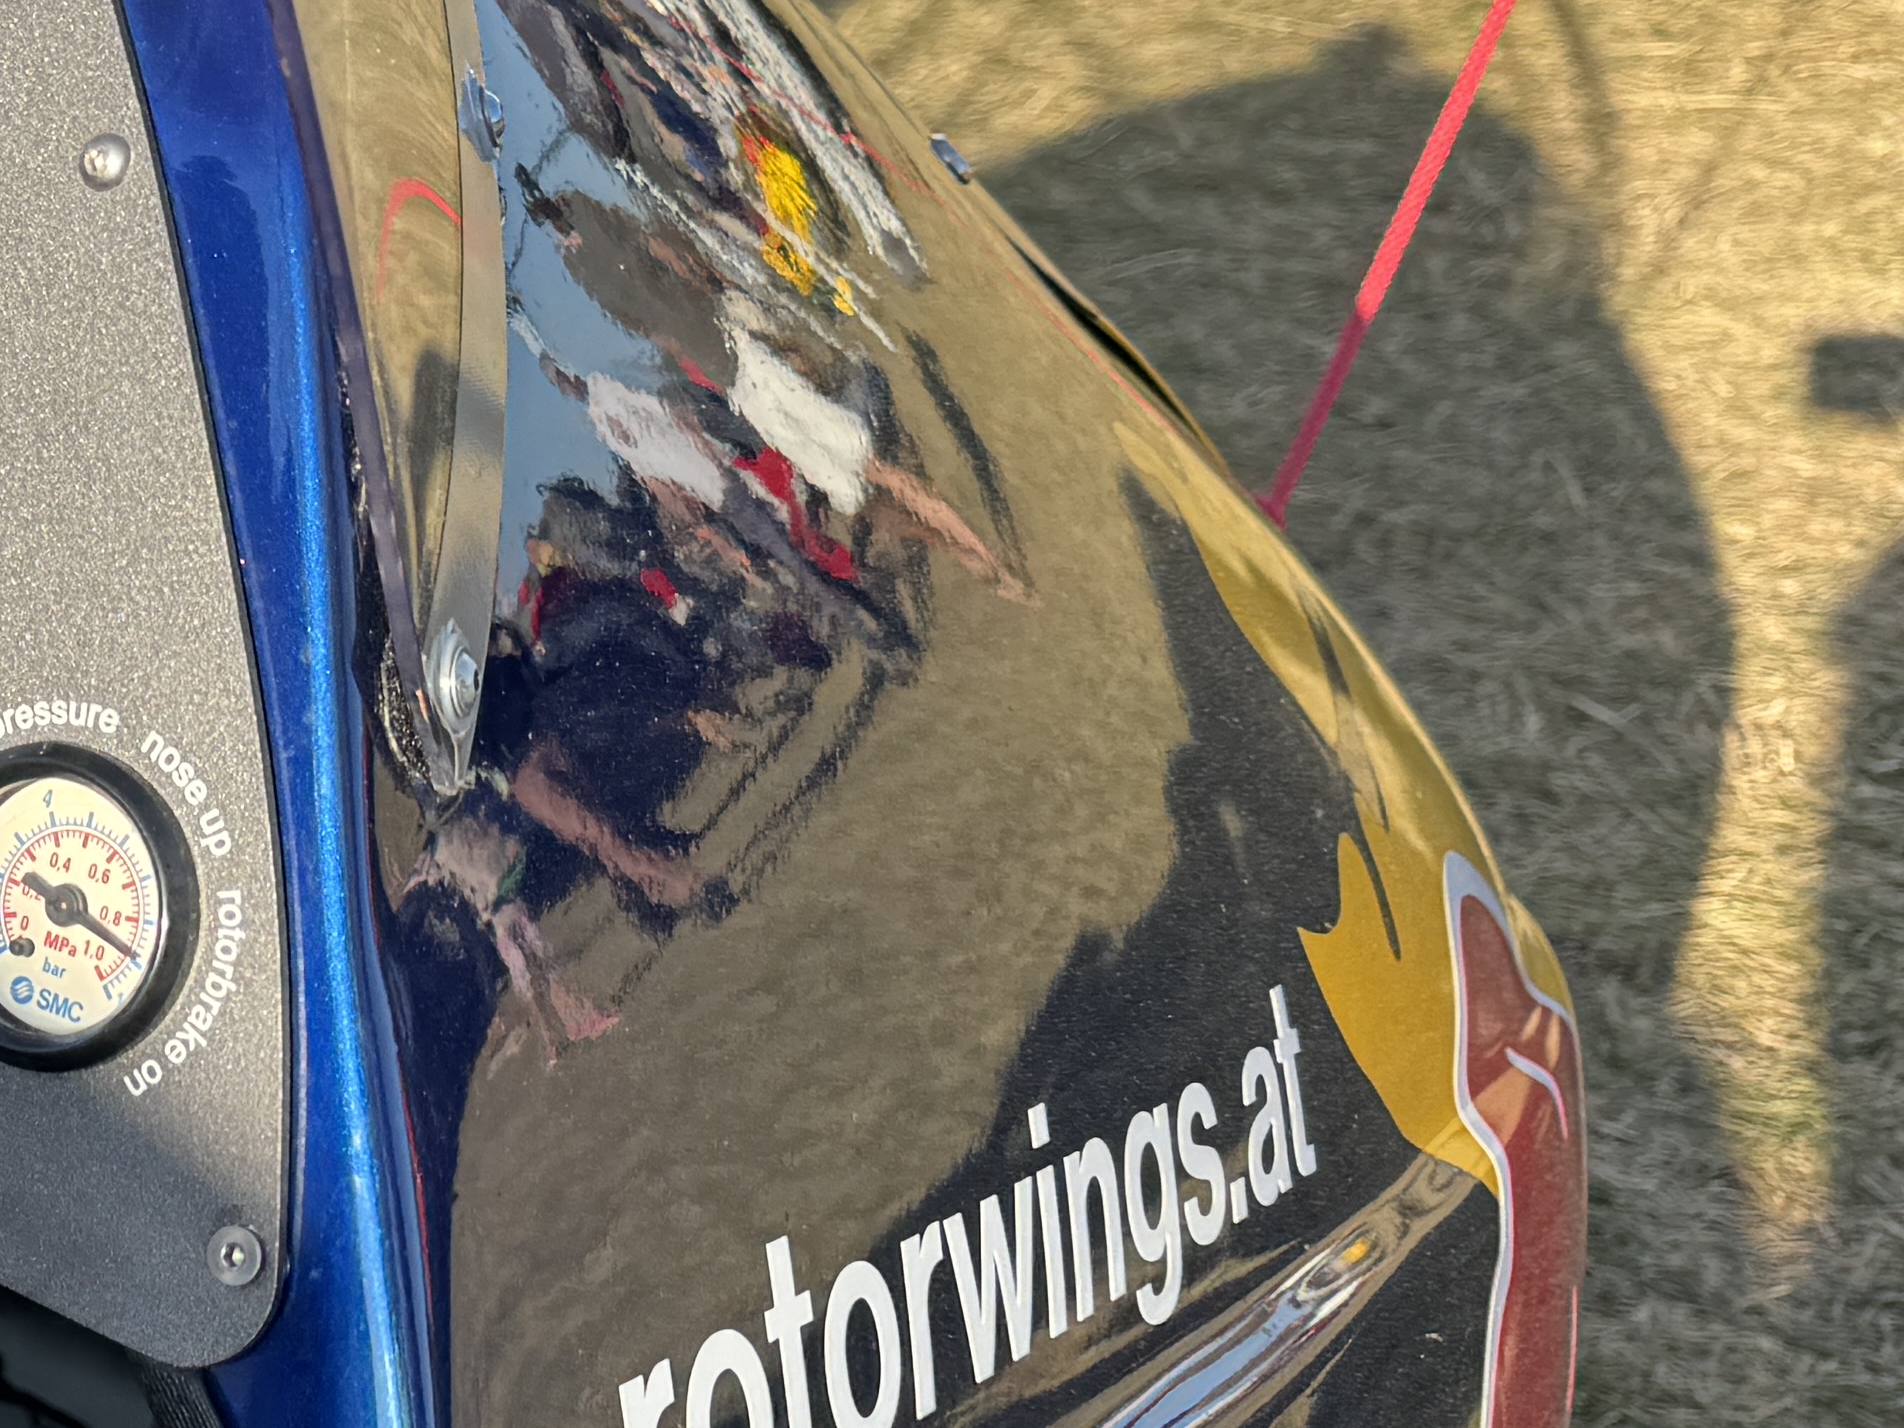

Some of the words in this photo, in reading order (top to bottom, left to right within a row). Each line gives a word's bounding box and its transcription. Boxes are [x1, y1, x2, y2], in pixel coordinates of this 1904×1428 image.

[42, 788, 54, 809] 4
[140, 729, 209, 805] nose
[199, 807, 233, 858] up
[49, 852, 72, 874] 0,4
[88, 863, 111, 885] 0,6
[20, 915, 30, 931] 0
[99, 905, 122, 927] 0,8
[44, 931, 78, 957] MPa
[84, 939, 105, 962] 1,0
[42, 957, 67, 979] bar
[163, 886, 243, 1065] rotorbrake
[36, 988, 84, 1024] SMC
[123, 1057, 164, 1098] on
